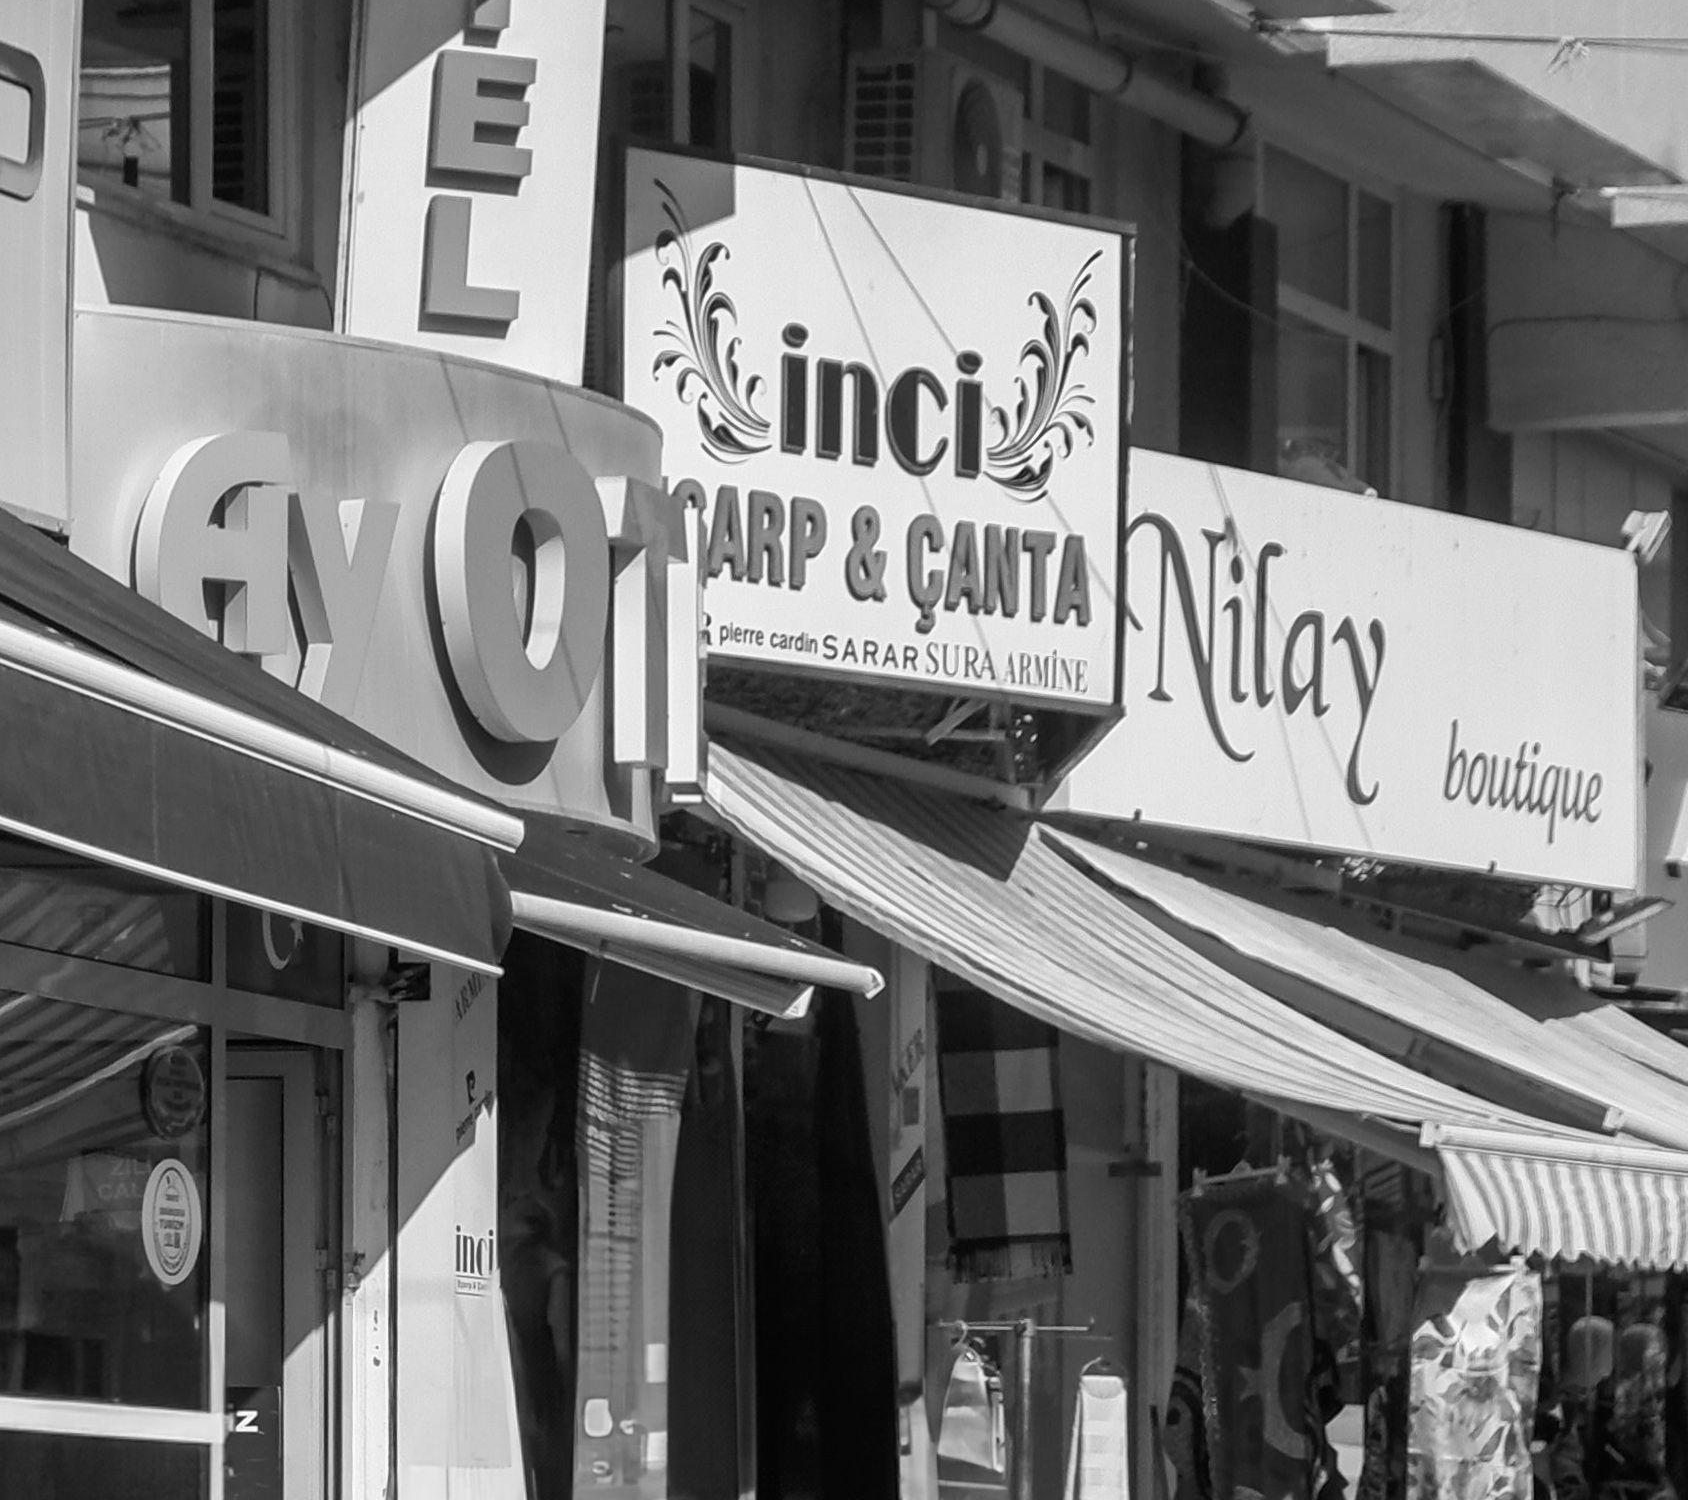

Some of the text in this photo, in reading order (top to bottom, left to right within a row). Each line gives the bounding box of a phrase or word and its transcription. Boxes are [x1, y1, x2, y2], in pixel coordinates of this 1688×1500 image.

[779, 321, 983, 480] inci
[846, 504, 888, 602] &
[906, 512, 1092, 634] ÇANTA
[718, 620, 765, 649] pierre
[769, 629, 819, 657] cardin
[822, 632, 919, 673] SARAR
[925, 642, 996, 682] SURA
[1002, 648, 1090, 696] ARMİNE
[1128, 511, 1604, 846] Nilay boutique
[455, 1224, 495, 1277] inci
